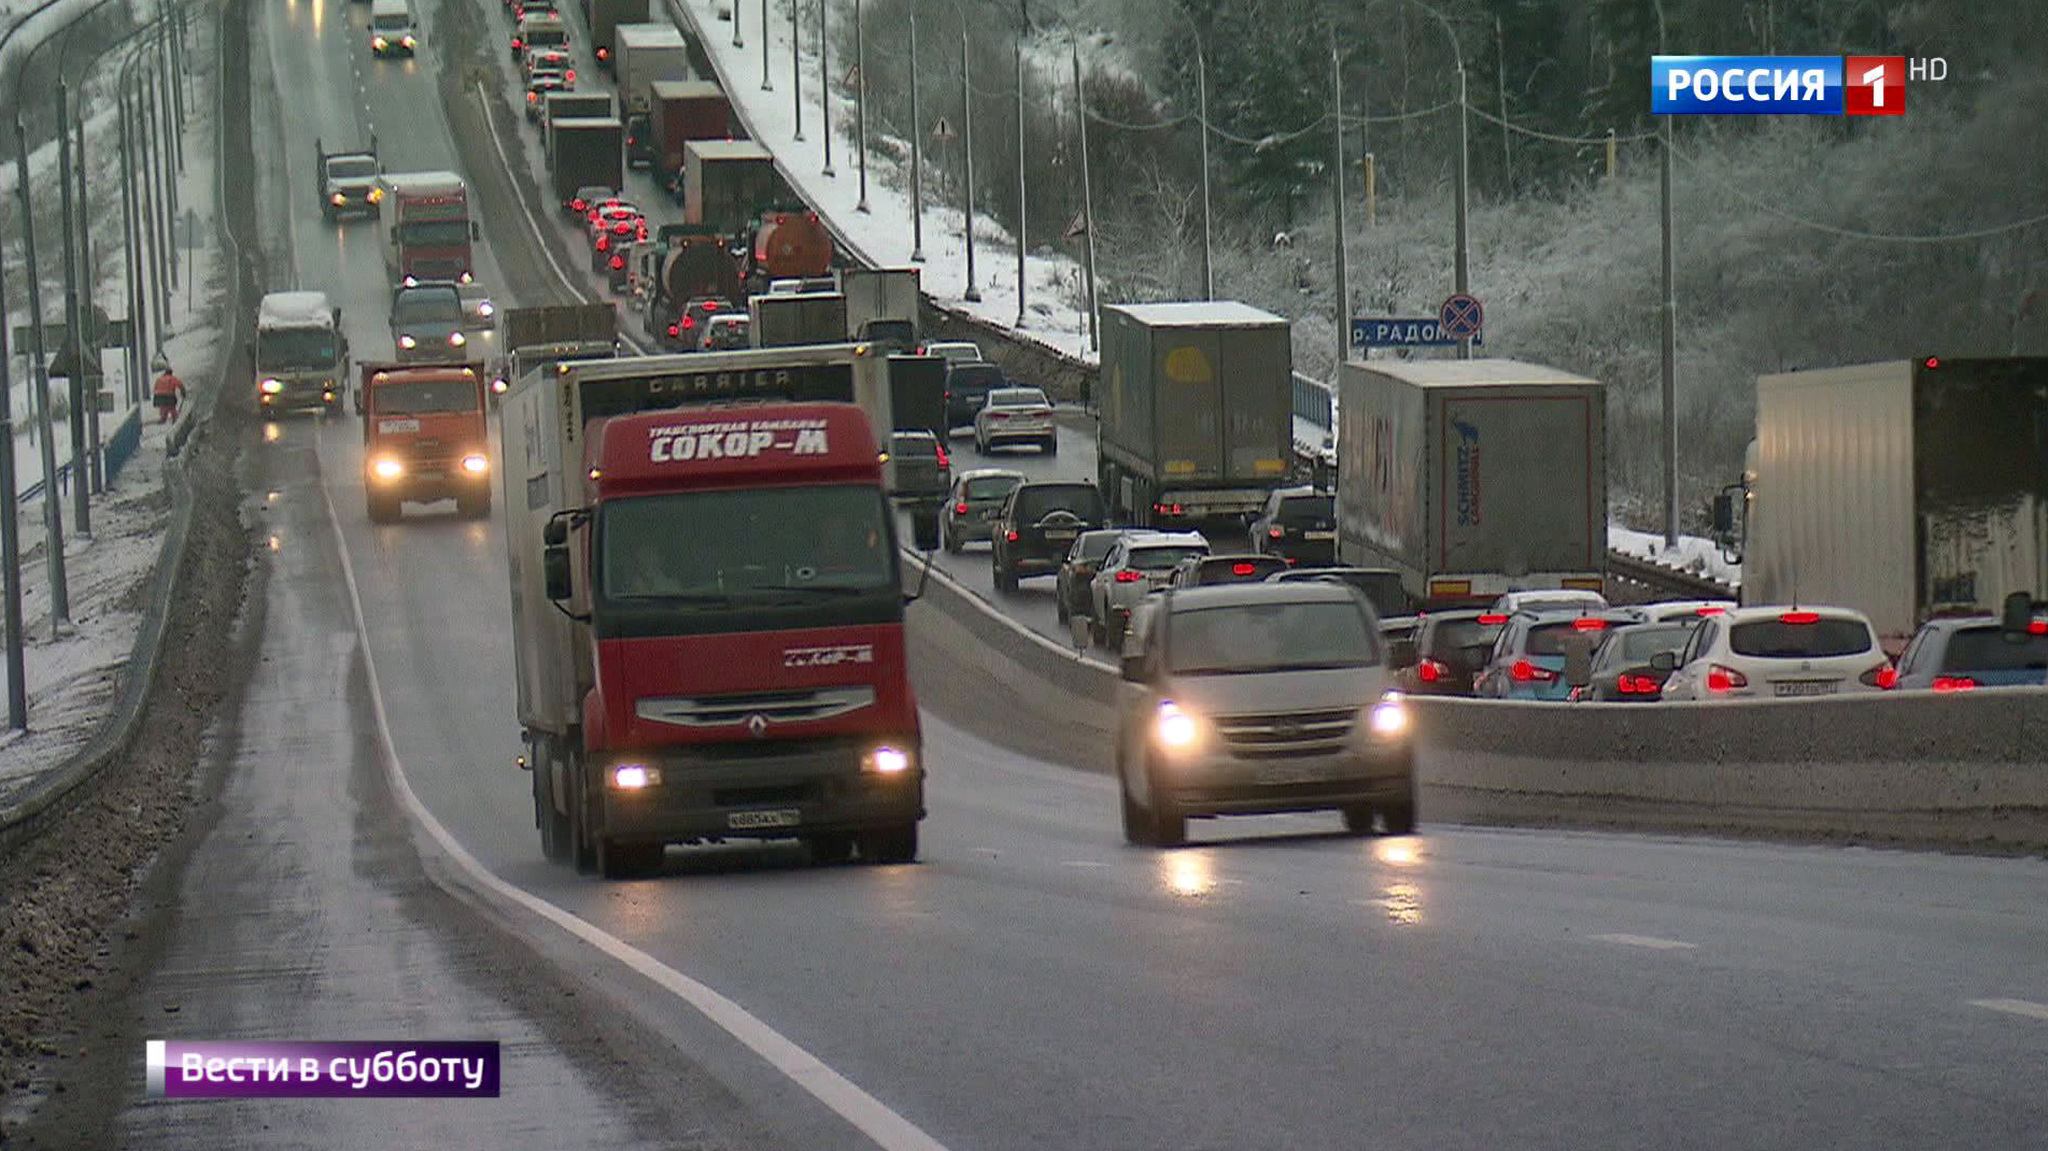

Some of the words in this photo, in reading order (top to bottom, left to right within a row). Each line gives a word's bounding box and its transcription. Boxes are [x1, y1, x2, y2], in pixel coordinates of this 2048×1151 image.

[1376, 323, 1481, 343] РАДОМ
[649, 370, 791, 394] CARRIER
[650, 429, 830, 463] СОКОР-М
